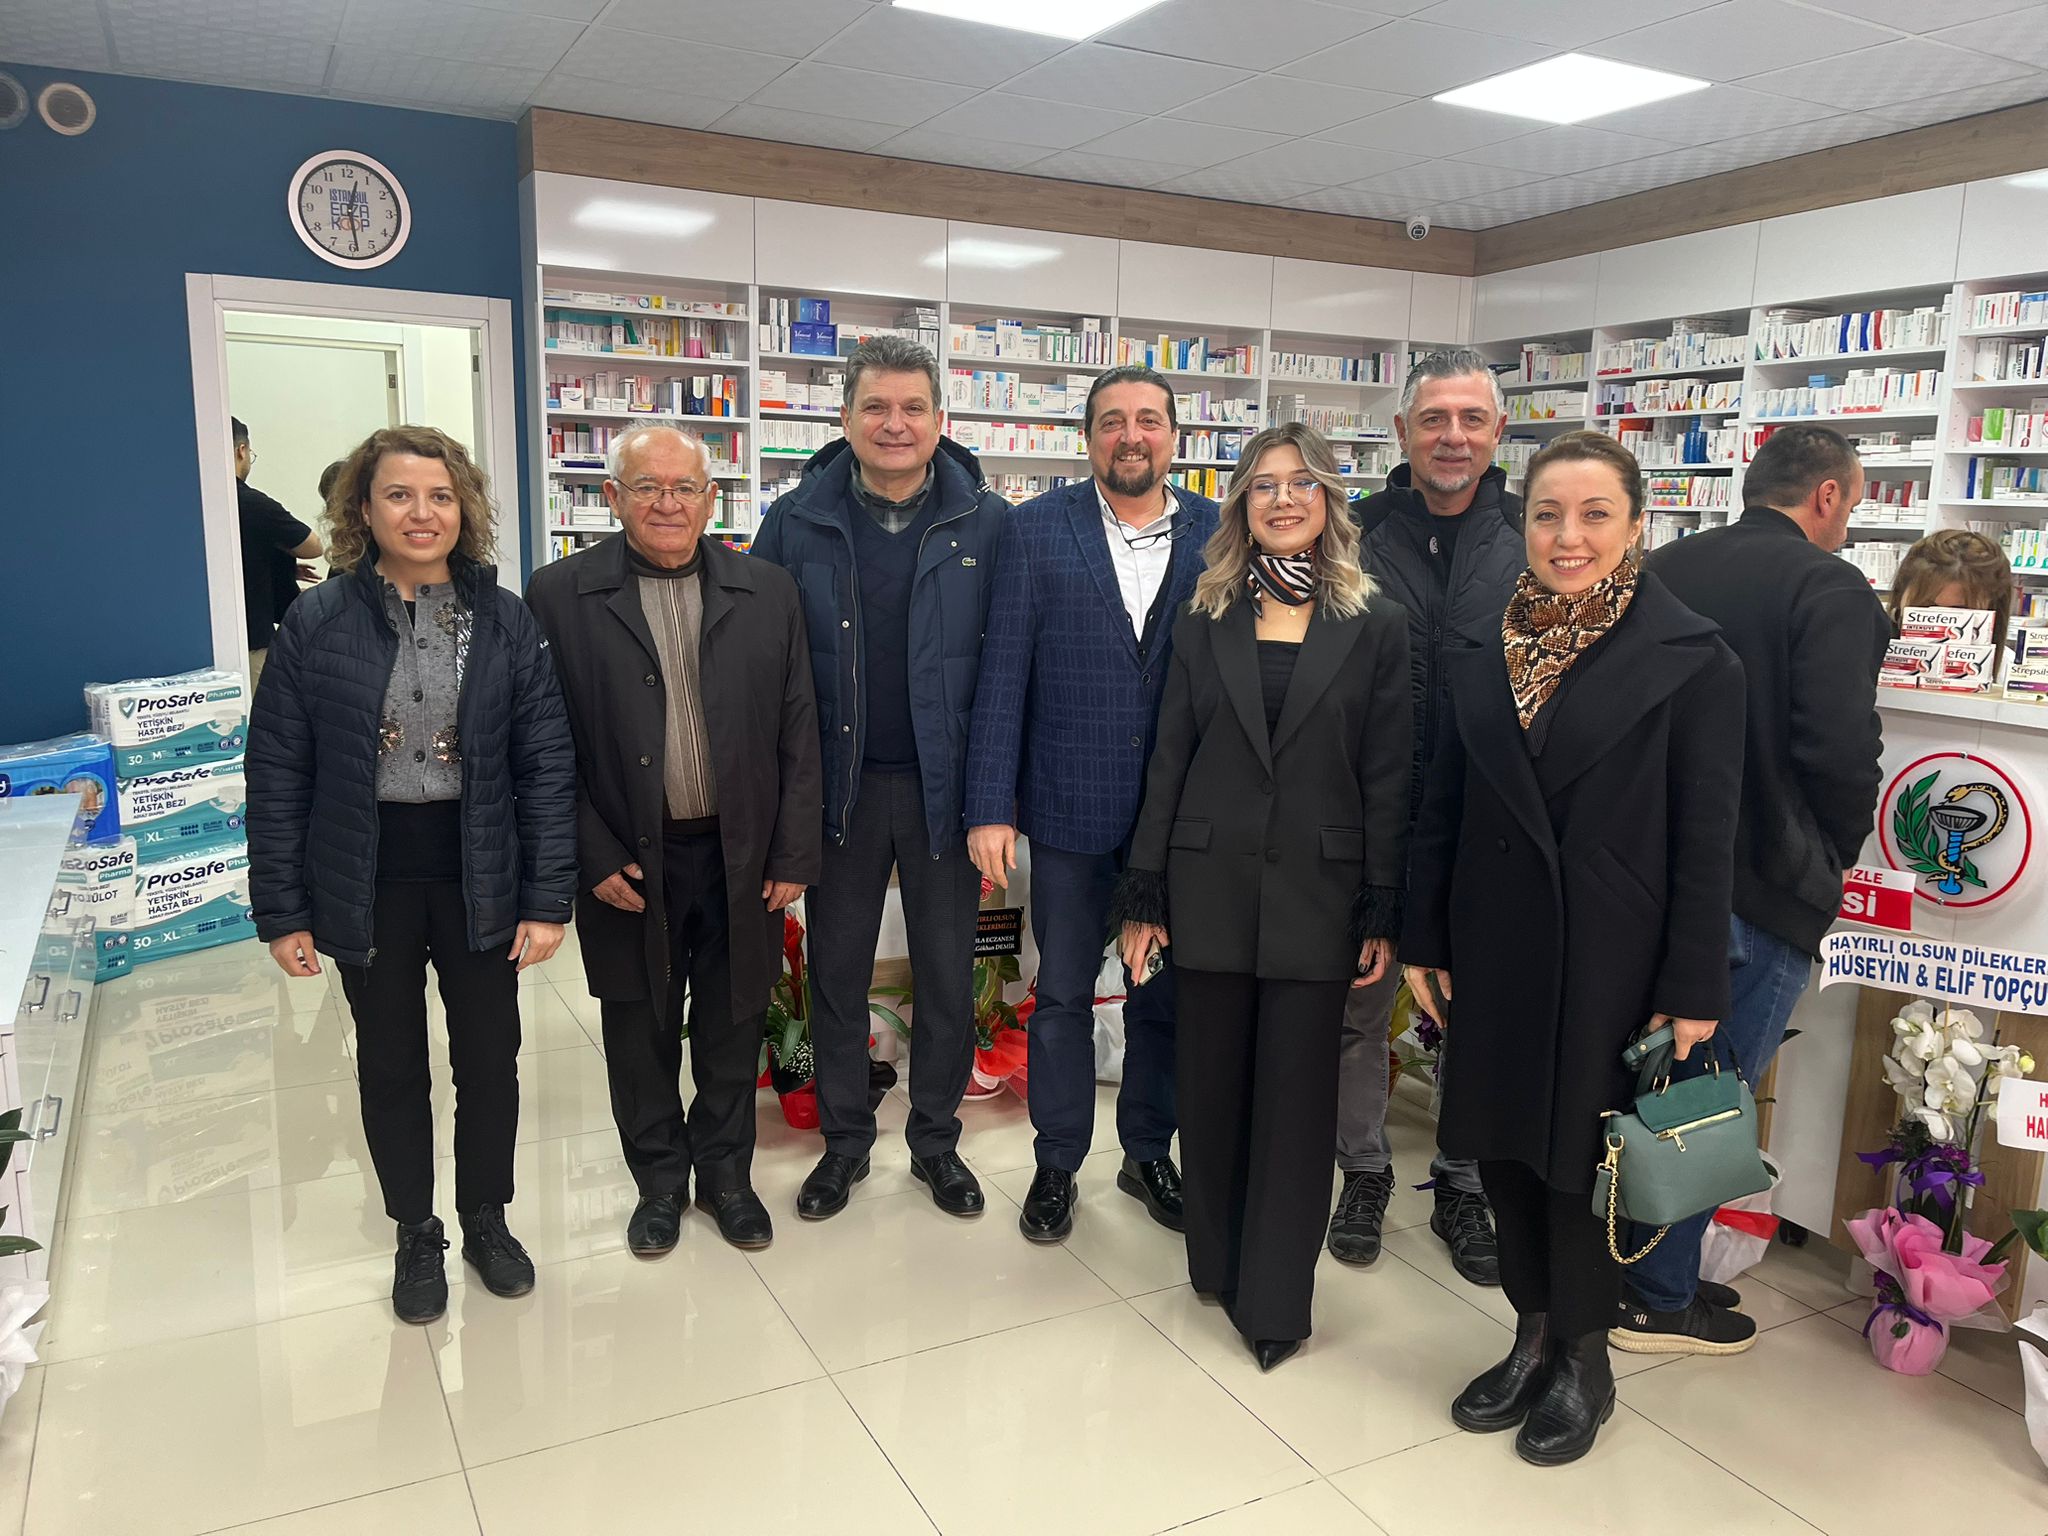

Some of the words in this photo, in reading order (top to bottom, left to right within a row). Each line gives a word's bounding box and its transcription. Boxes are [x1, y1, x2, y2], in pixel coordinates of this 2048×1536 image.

[324, 172, 333, 182] 11
[341, 168, 354, 179] 12
[365, 176, 370, 186] 1
[311, 185, 323, 195] 10
[379, 190, 386, 200] 2
[306, 203, 314, 212] 9
[386, 210, 393, 219] 3
[314, 222, 322, 231] 8
[331, 216, 370, 232] KOOP
[381, 228, 388, 237] 4
[330, 237, 338, 246] 7
[368, 240, 375, 249] 5
[348, 243, 357, 253] 6
[1907, 612, 1957, 624] Strefen
[1887, 644, 1928, 657] Strefen
[1947, 649, 1976, 660] efen
[137, 692, 205, 713] ProSafe
[207, 689, 240, 699] Pharma
[137, 717, 173, 729] YETİŞKİN
[138, 727, 164, 737] HASTA
[167, 722, 184, 732] BEZİ
[128, 755, 143, 766] 30
[153, 752, 162, 760] M
[133, 768, 211, 788] ProSafe
[132, 791, 174, 804] YETİŞKİN
[133, 802, 164, 813] HASTA
[166, 797, 186, 808] BEZİ
[147, 832, 163, 842] XL
[88, 851, 134, 871] oSafe
[100, 867, 132, 880] Pharma
[147, 861, 225, 889] ProSafe
[147, 890, 189, 905] YETİŞKİN
[1842, 890, 1876, 917] Sİ
[148, 902, 180, 914] HASTA
[182, 894, 203, 906] BEZİ
[133, 936, 152, 950] 30
[163, 931, 180, 943] XL
[1829, 936, 1894, 954] HAYIRLI
[1899, 941, 1956, 962] OLSUN
[1962, 947, 2046, 975] DİLEKLER
[1829, 950, 1909, 985] HÜSEYİN
[1916, 963, 1929, 987] &
[1935, 964, 1976, 996] ELİF
[1982, 974, 2047, 1011] TOPÇU
